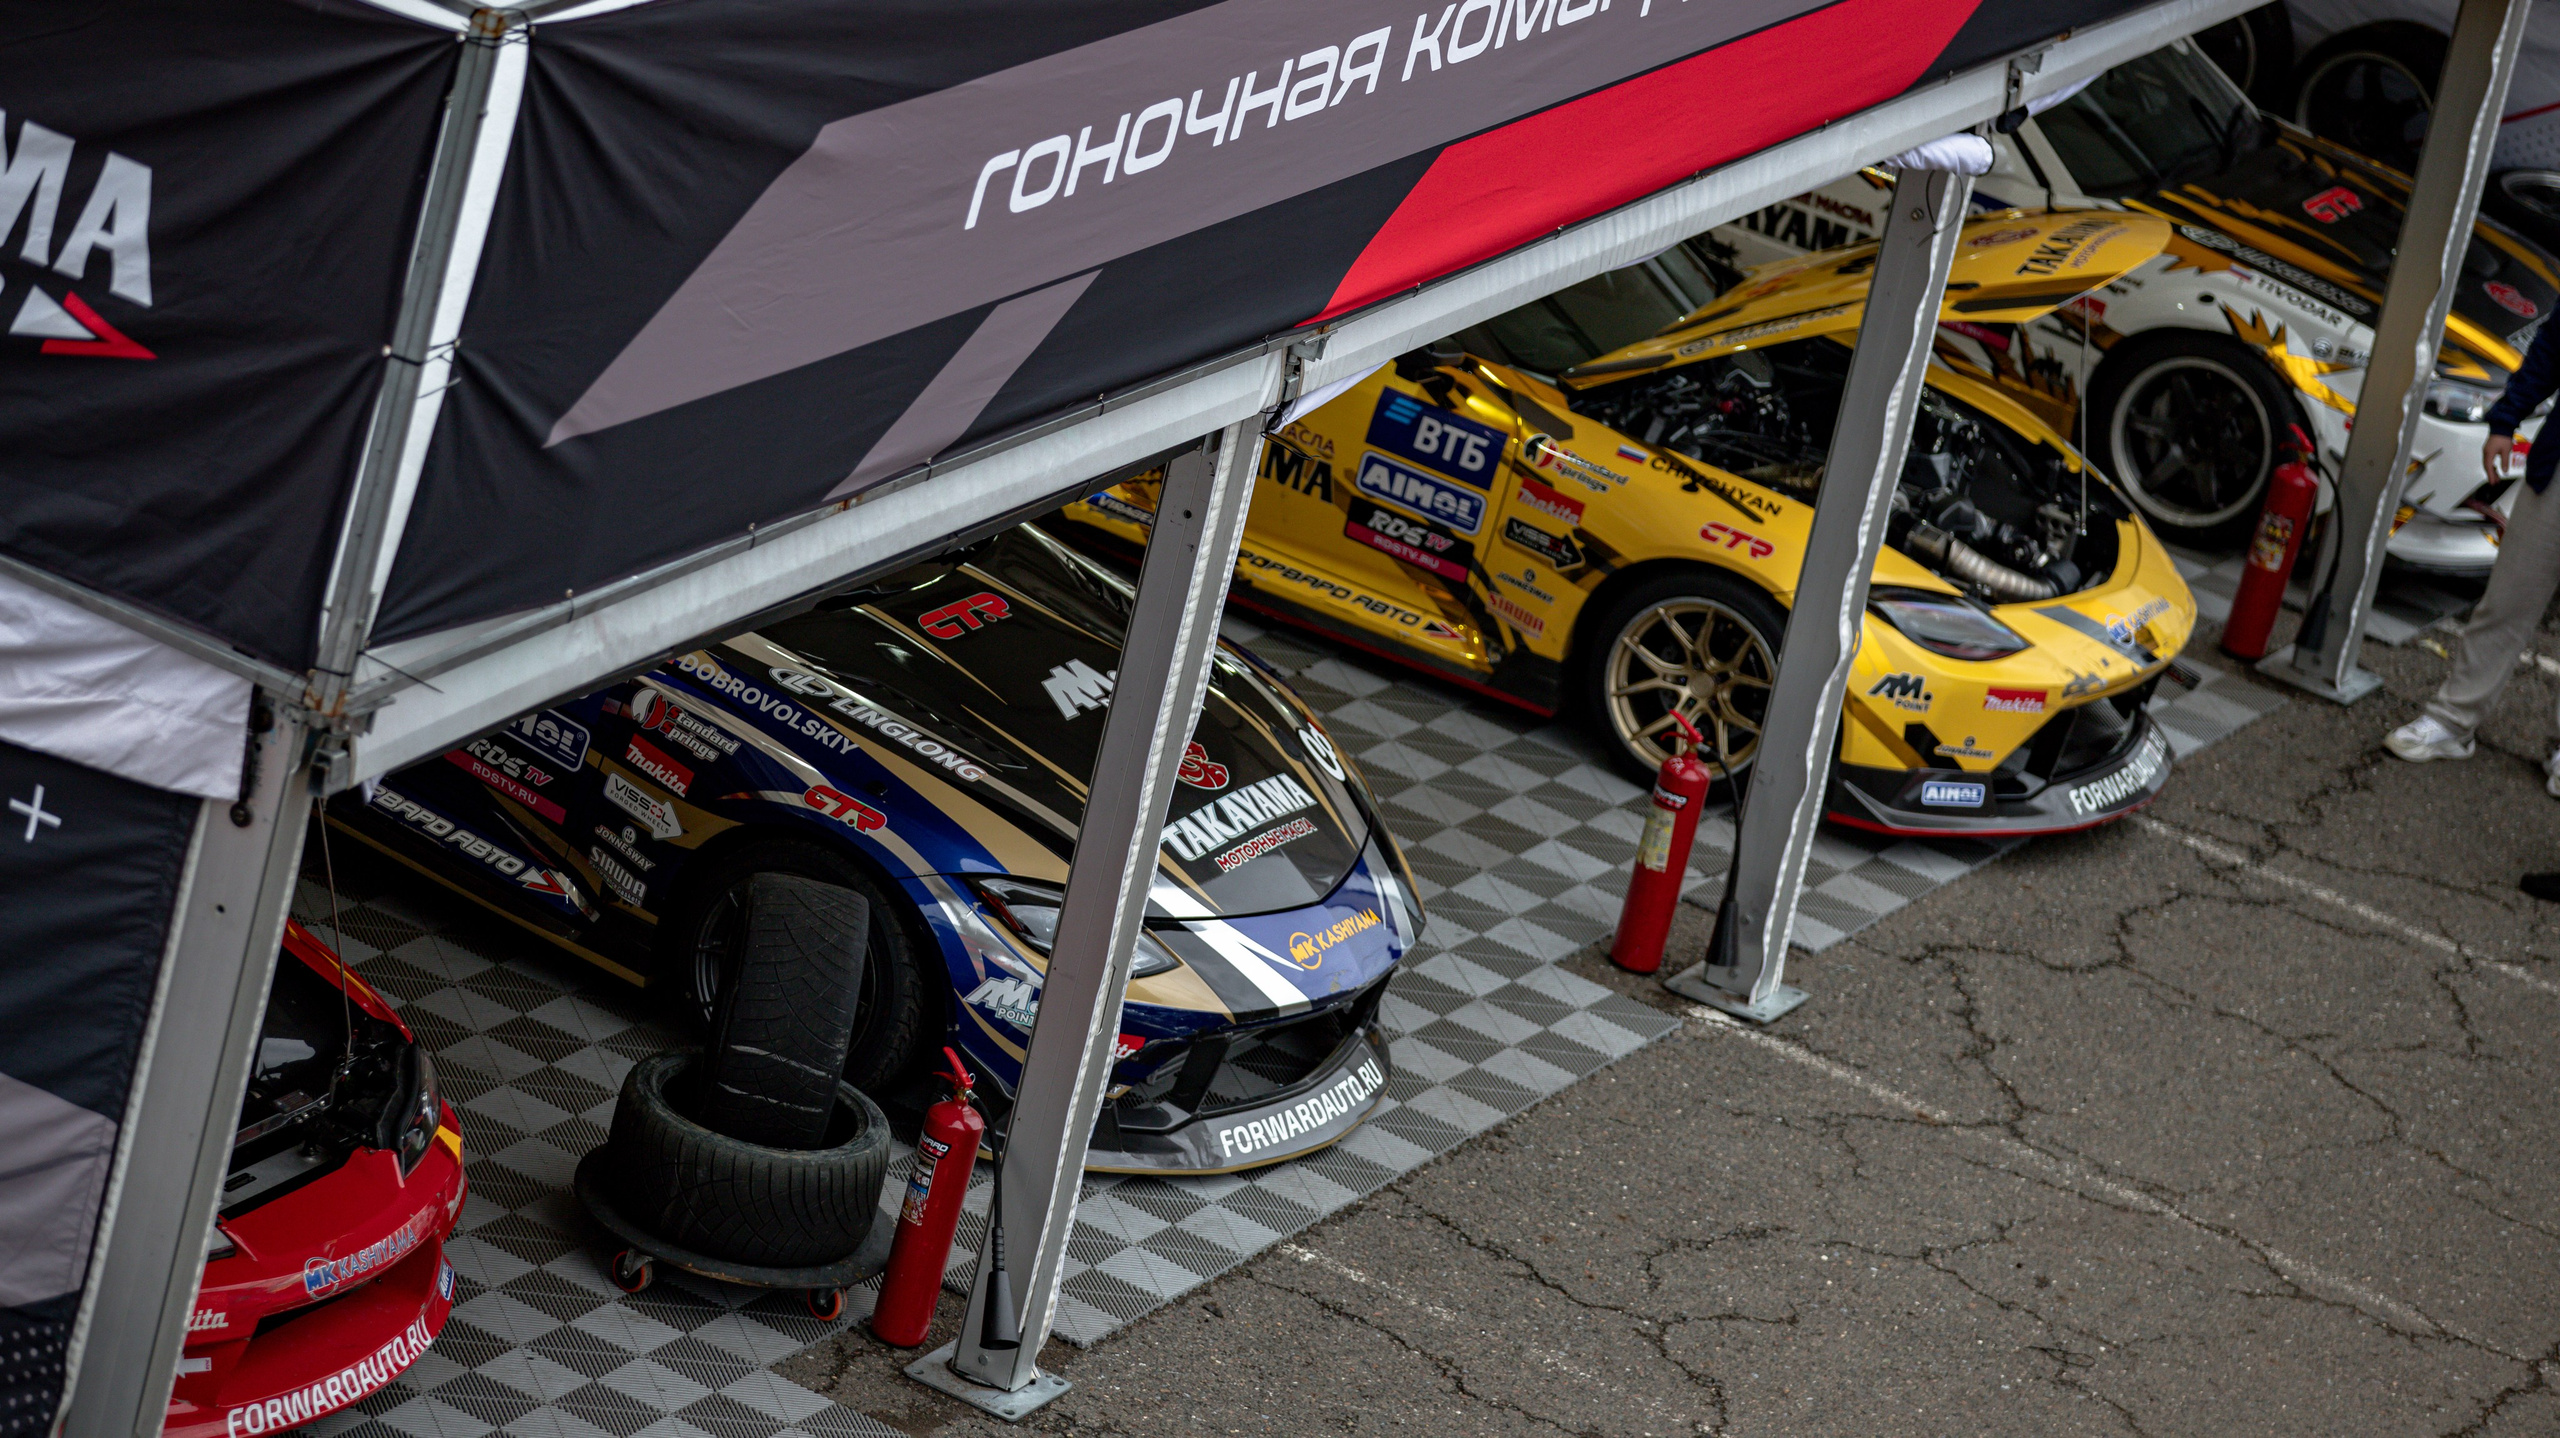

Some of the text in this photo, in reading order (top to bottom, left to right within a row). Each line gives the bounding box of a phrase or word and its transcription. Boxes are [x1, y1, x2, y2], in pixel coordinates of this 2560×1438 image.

[2256, 277, 2344, 328] TIVODAR
[1281, 425, 1336, 455] АСЛА
[1413, 415, 1490, 473] ВТБ
[1362, 463, 1475, 524] AIMOL
[1553, 461, 1610, 494] Springs
[1373, 534, 1440, 570] RDSTV.RU
[679, 653, 860, 755] DOBROVOLSKIY
[1894, 699, 1931, 713] POINT
[659, 719, 720, 763] Springs
[667, 704, 742, 756] Standard
[829, 696, 989, 783] LINGLONG
[472, 761, 538, 805] RDSTV.RU
[614, 778, 672, 828] VISSOL
[609, 789, 670, 835] FORGED WHEELS
[1160, 773, 1318, 861] TAKAYAMA
[596, 826, 652, 870] JONNESWAY
[1215, 817, 1319, 873] МОТОРНЫЕ МАСЛА
[1315, 907, 1382, 951] KASHIYAMA
[1219, 1057, 1384, 1158] FORWARDAUTO.RU
[338, 1224, 418, 1281] KASHIYAMA
[227, 1315, 433, 1438] FORWARDAUTO.RU
